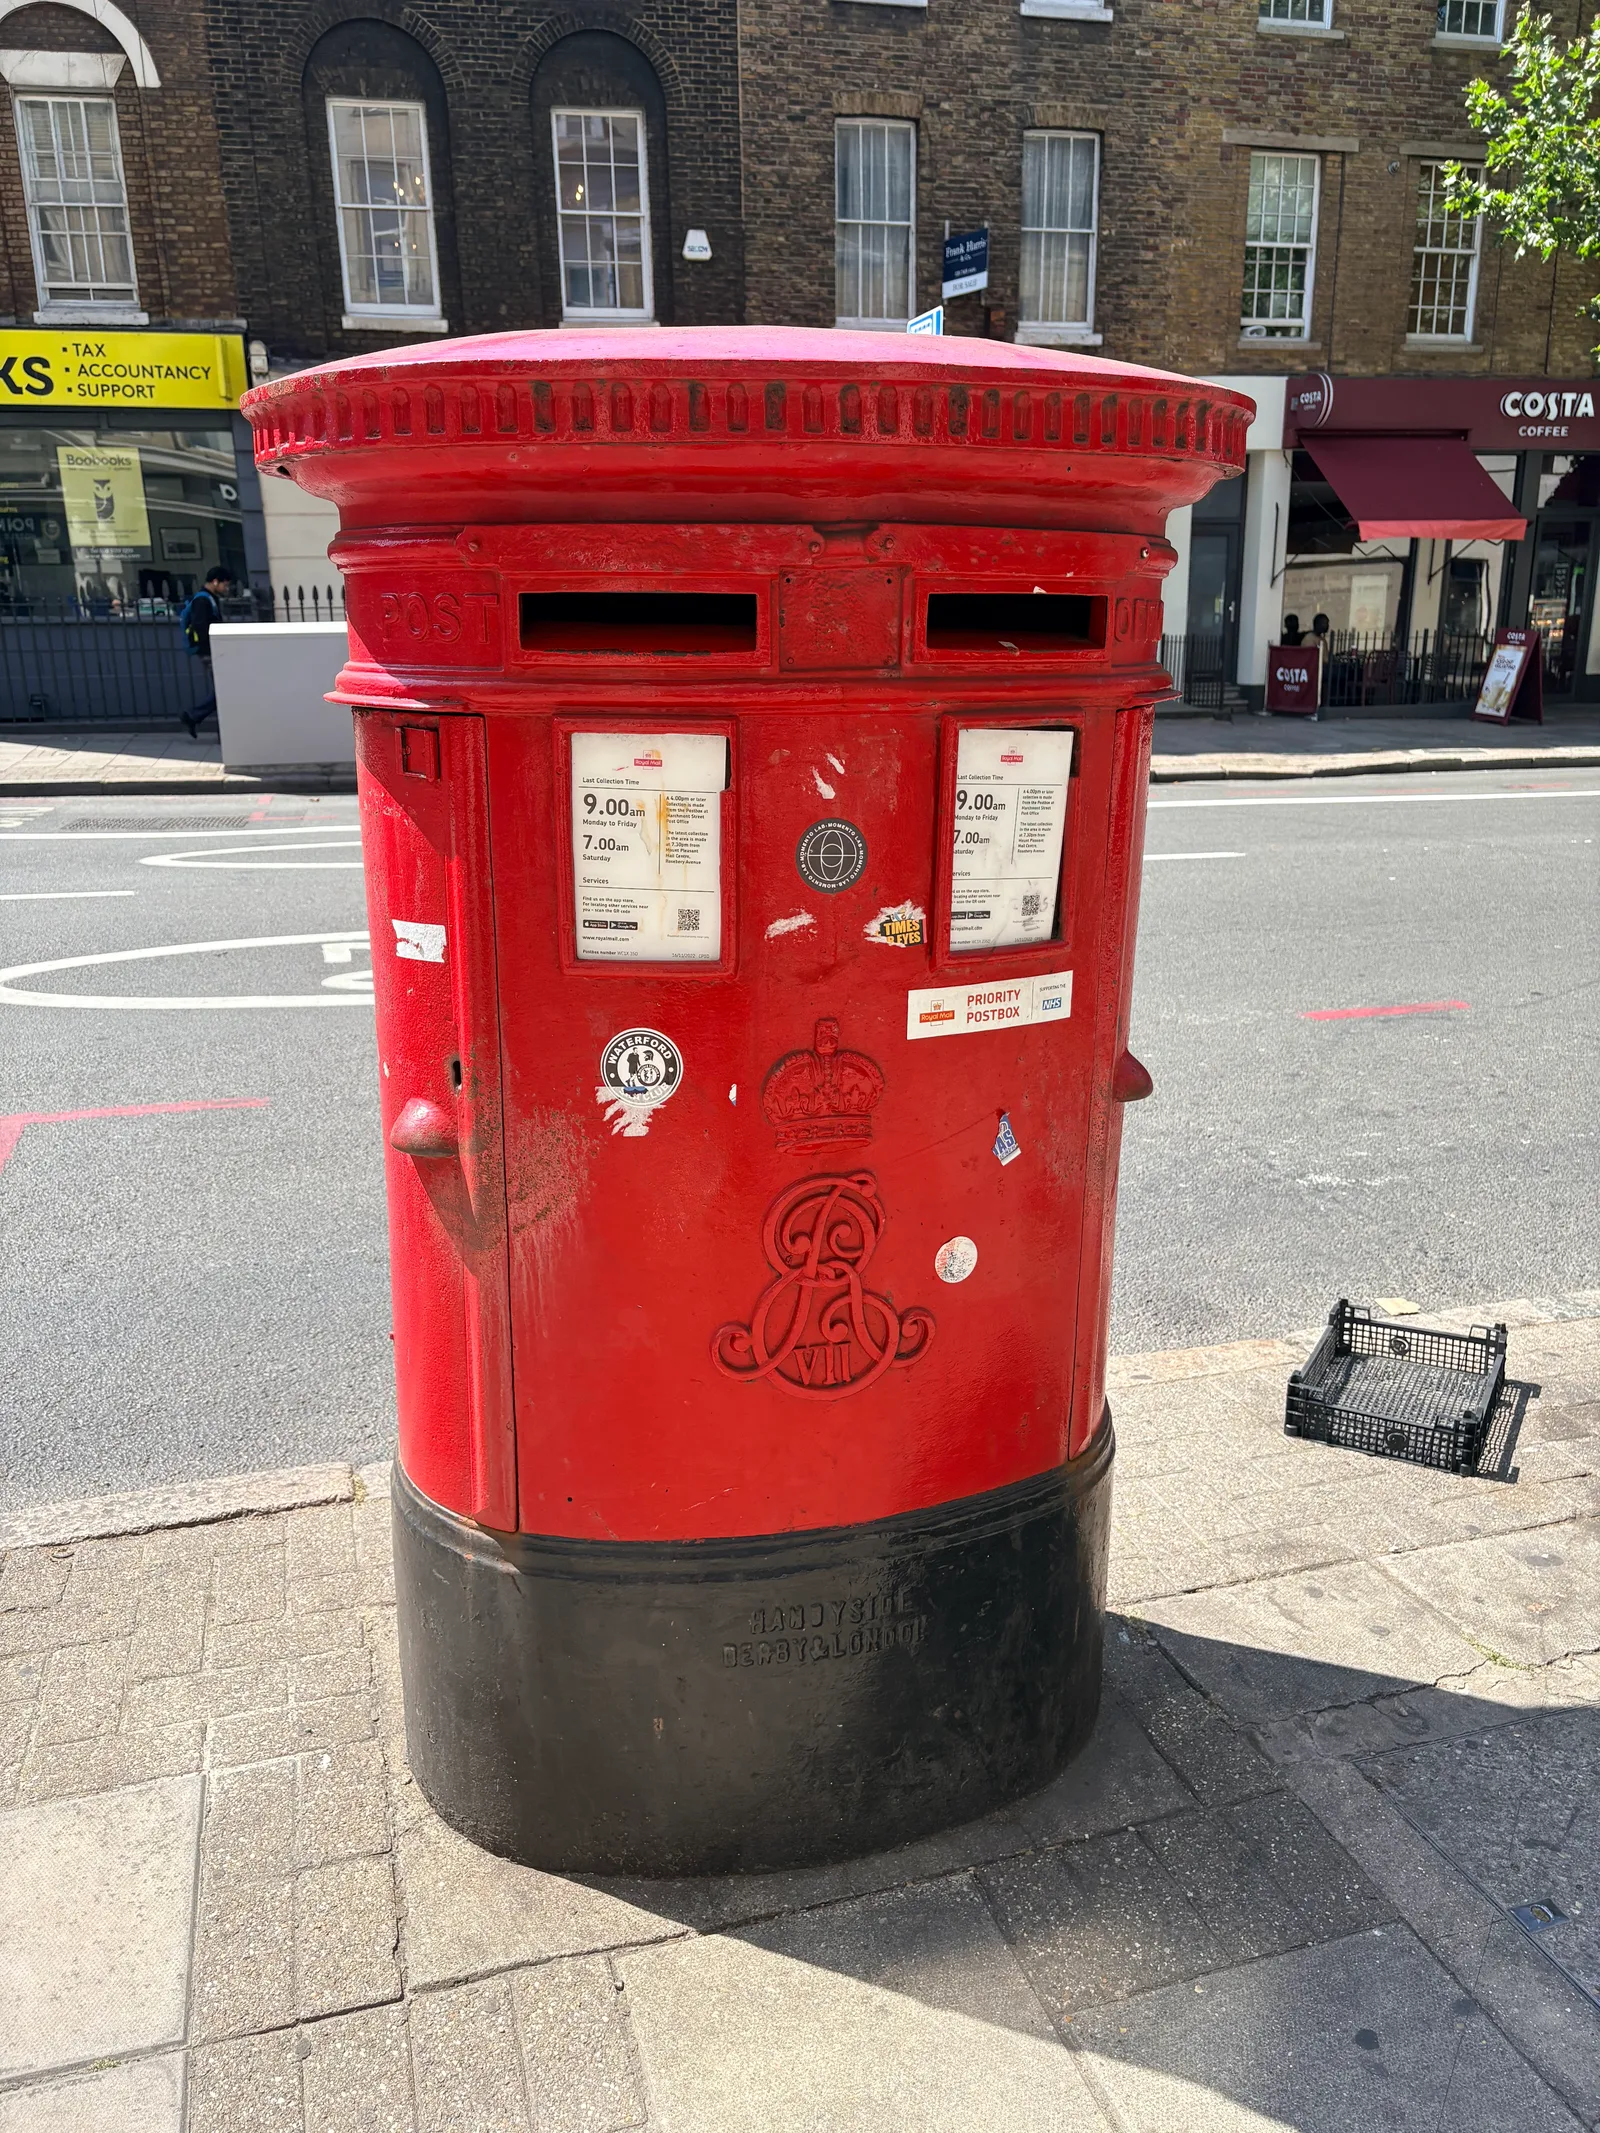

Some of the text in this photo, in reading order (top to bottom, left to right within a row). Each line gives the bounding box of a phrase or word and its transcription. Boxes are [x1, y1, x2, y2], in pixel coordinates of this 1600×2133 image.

[72, 343, 106, 357] TAX
[78, 363, 211, 380] ACCOUNTANCY
[78, 383, 156, 398] SUPPORT
[1300, 391, 1321, 404] COSTA
[1501, 391, 1595, 420] COSTA
[1518, 426, 1569, 437] COFFEE
[66, 453, 132, 466] Boobooks
[381, 592, 499, 644] POST
[1276, 667, 1309, 684] COSTA
[583, 793, 646, 816] 9.00am
[956, 789, 1006, 810] 9.00am
[583, 819, 607, 827] Monday
[618, 820, 637, 828] Friday
[583, 834, 629, 851] 7.00am
[800, 831, 814, 861] MOMENTO
[828, 823, 856, 836] MOMENTO
[954, 829, 990, 844] 7.00am
[583, 853, 611, 862] Saturday
[583, 876, 609, 884] Services
[884, 919, 920, 936] TIMES
[897, 931, 921, 945] EYES
[1039, 984, 1059, 992] SUPPORTING
[967, 989, 1021, 1007] PRIORITY
[1042, 998, 1061, 1010] NHS
[921, 1010, 953, 1022] Royal Mail
[966, 1006, 1020, 1024] POSTBOX
[607, 1036, 672, 1064] WATERFORD
[643, 1082, 669, 1100] CLUB
